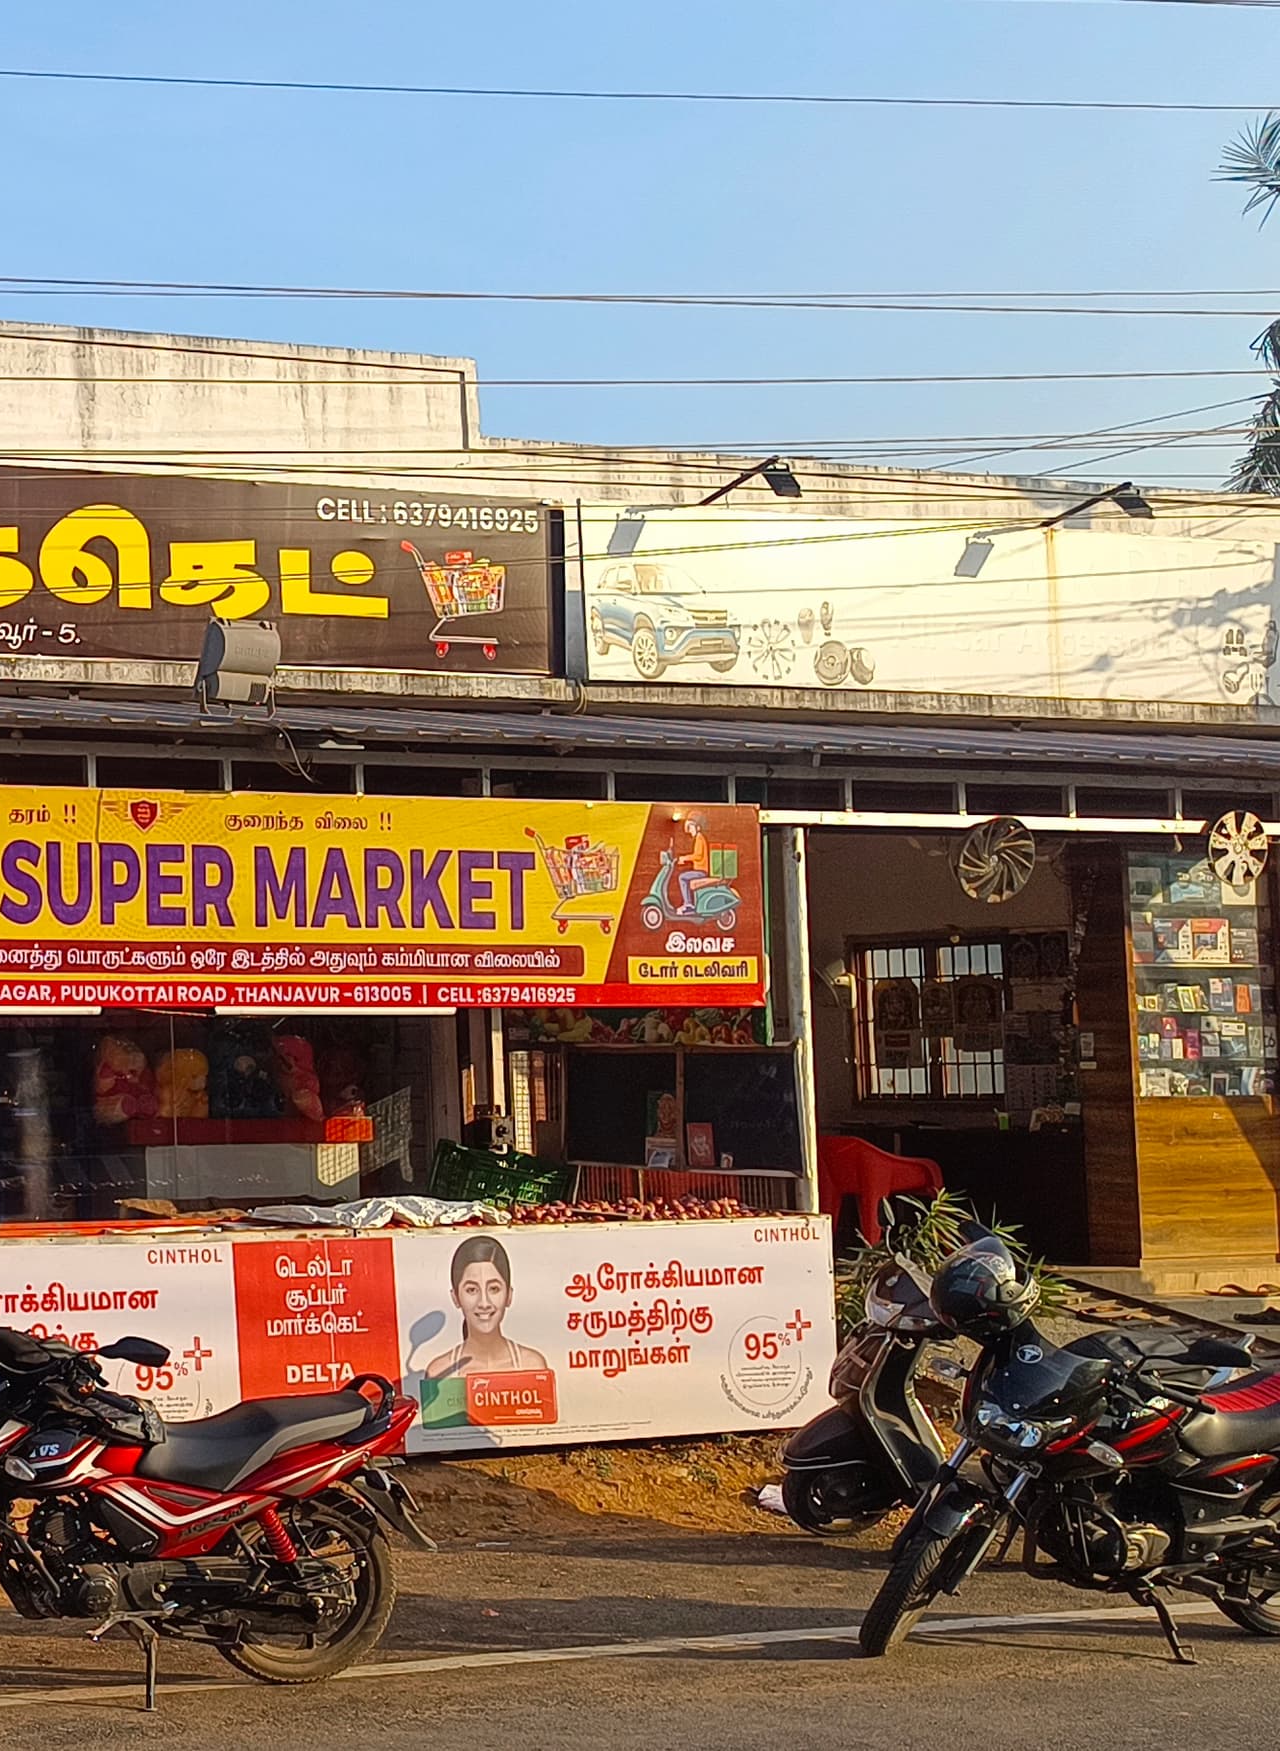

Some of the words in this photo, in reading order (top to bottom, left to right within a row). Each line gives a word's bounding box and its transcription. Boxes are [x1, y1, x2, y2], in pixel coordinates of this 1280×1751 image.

[317, 497, 378, 524] CELL
[393, 501, 539, 533] 6379416925
[58, 624, 81, 644] 5.
[8, 802, 52, 825] தரம்
[224, 811, 304, 832] குறைந்த
[315, 810, 368, 831] விலை
[251, 845, 537, 932] MARKET
[665, 930, 736, 954] இலவச
[67, 941, 186, 970] பொருட்களும்
[190, 949, 226, 972] ஒரே
[231, 944, 304, 971] இடத்தில்
[309, 948, 377, 972] அதுவும்
[381, 946, 471, 969] கம்மியான
[474, 944, 561, 970] விலையில்
[638, 960, 678, 978] டோர்
[683, 960, 749, 978] டெலிவரி
[60, 983, 173, 1003] PUDUKOTTAI
[175, 985, 227, 1003] ROAD
[753, 1226, 821, 1243] CINTHOL
[147, 1247, 223, 1264] CINTHOL
[275, 1254, 354, 1279] டெல்டா
[564, 1262, 766, 1302] ஆரோக்கியமான
[285, 1282, 349, 1312] சூப்பர்
[266, 1310, 370, 1337] மார்க்கெட்
[566, 1299, 713, 1339] சருமத்திற்கு
[568, 1338, 692, 1377] மாறுங்கள்
[744, 1332, 791, 1361] 95%
[286, 1361, 355, 1385] DELTA
[474, 1390, 542, 1407] CINTHOL
[29, 1443, 60, 1458] TVS
